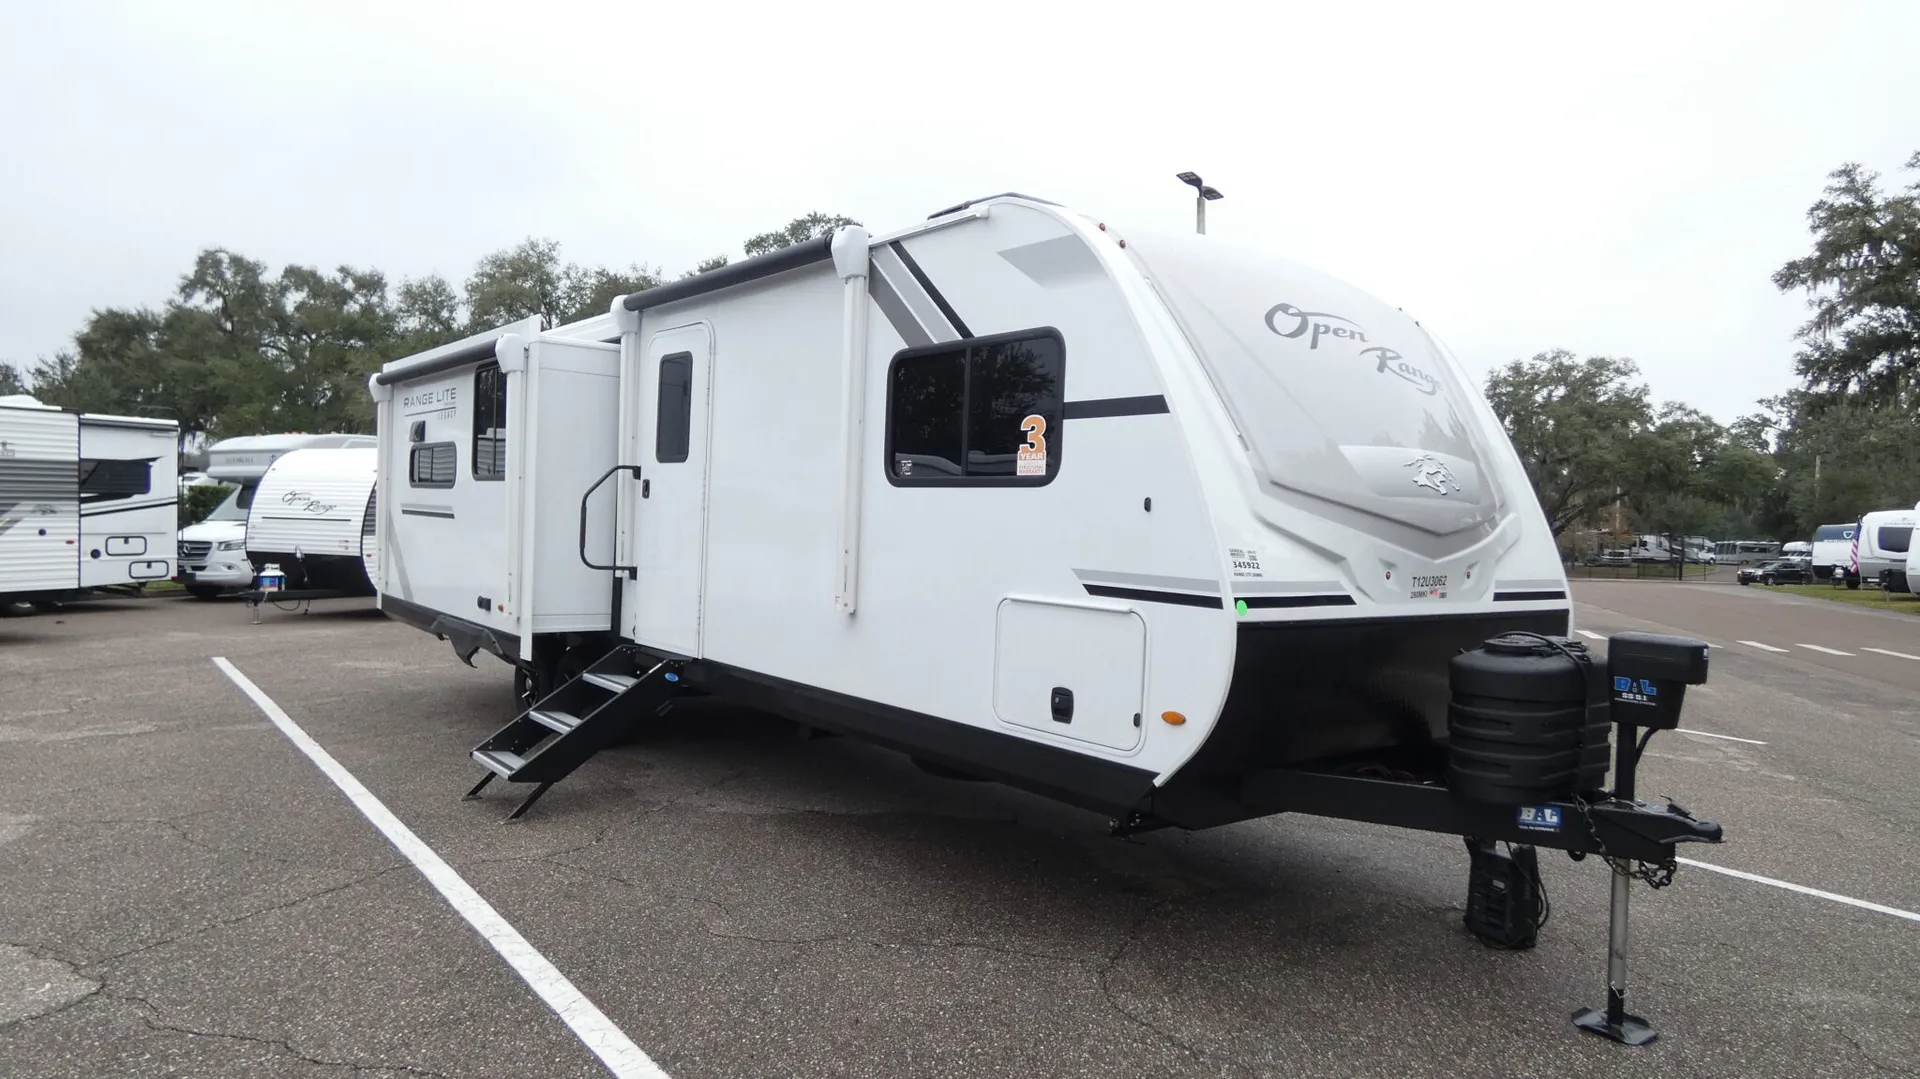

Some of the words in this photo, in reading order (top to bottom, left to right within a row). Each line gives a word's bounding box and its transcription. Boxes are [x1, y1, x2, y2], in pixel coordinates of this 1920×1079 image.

[1265, 303, 1368, 349] Open
[1359, 347, 1443, 396] Range
[404, 392, 434, 408] RANGE
[436, 387, 457, 402] LITE
[1020, 414, 1046, 452] 3
[282, 490, 313, 506] Open
[301, 500, 338, 516] Range
[1232, 560, 1261, 570] 345922
[1412, 575, 1448, 588] T12U3062
